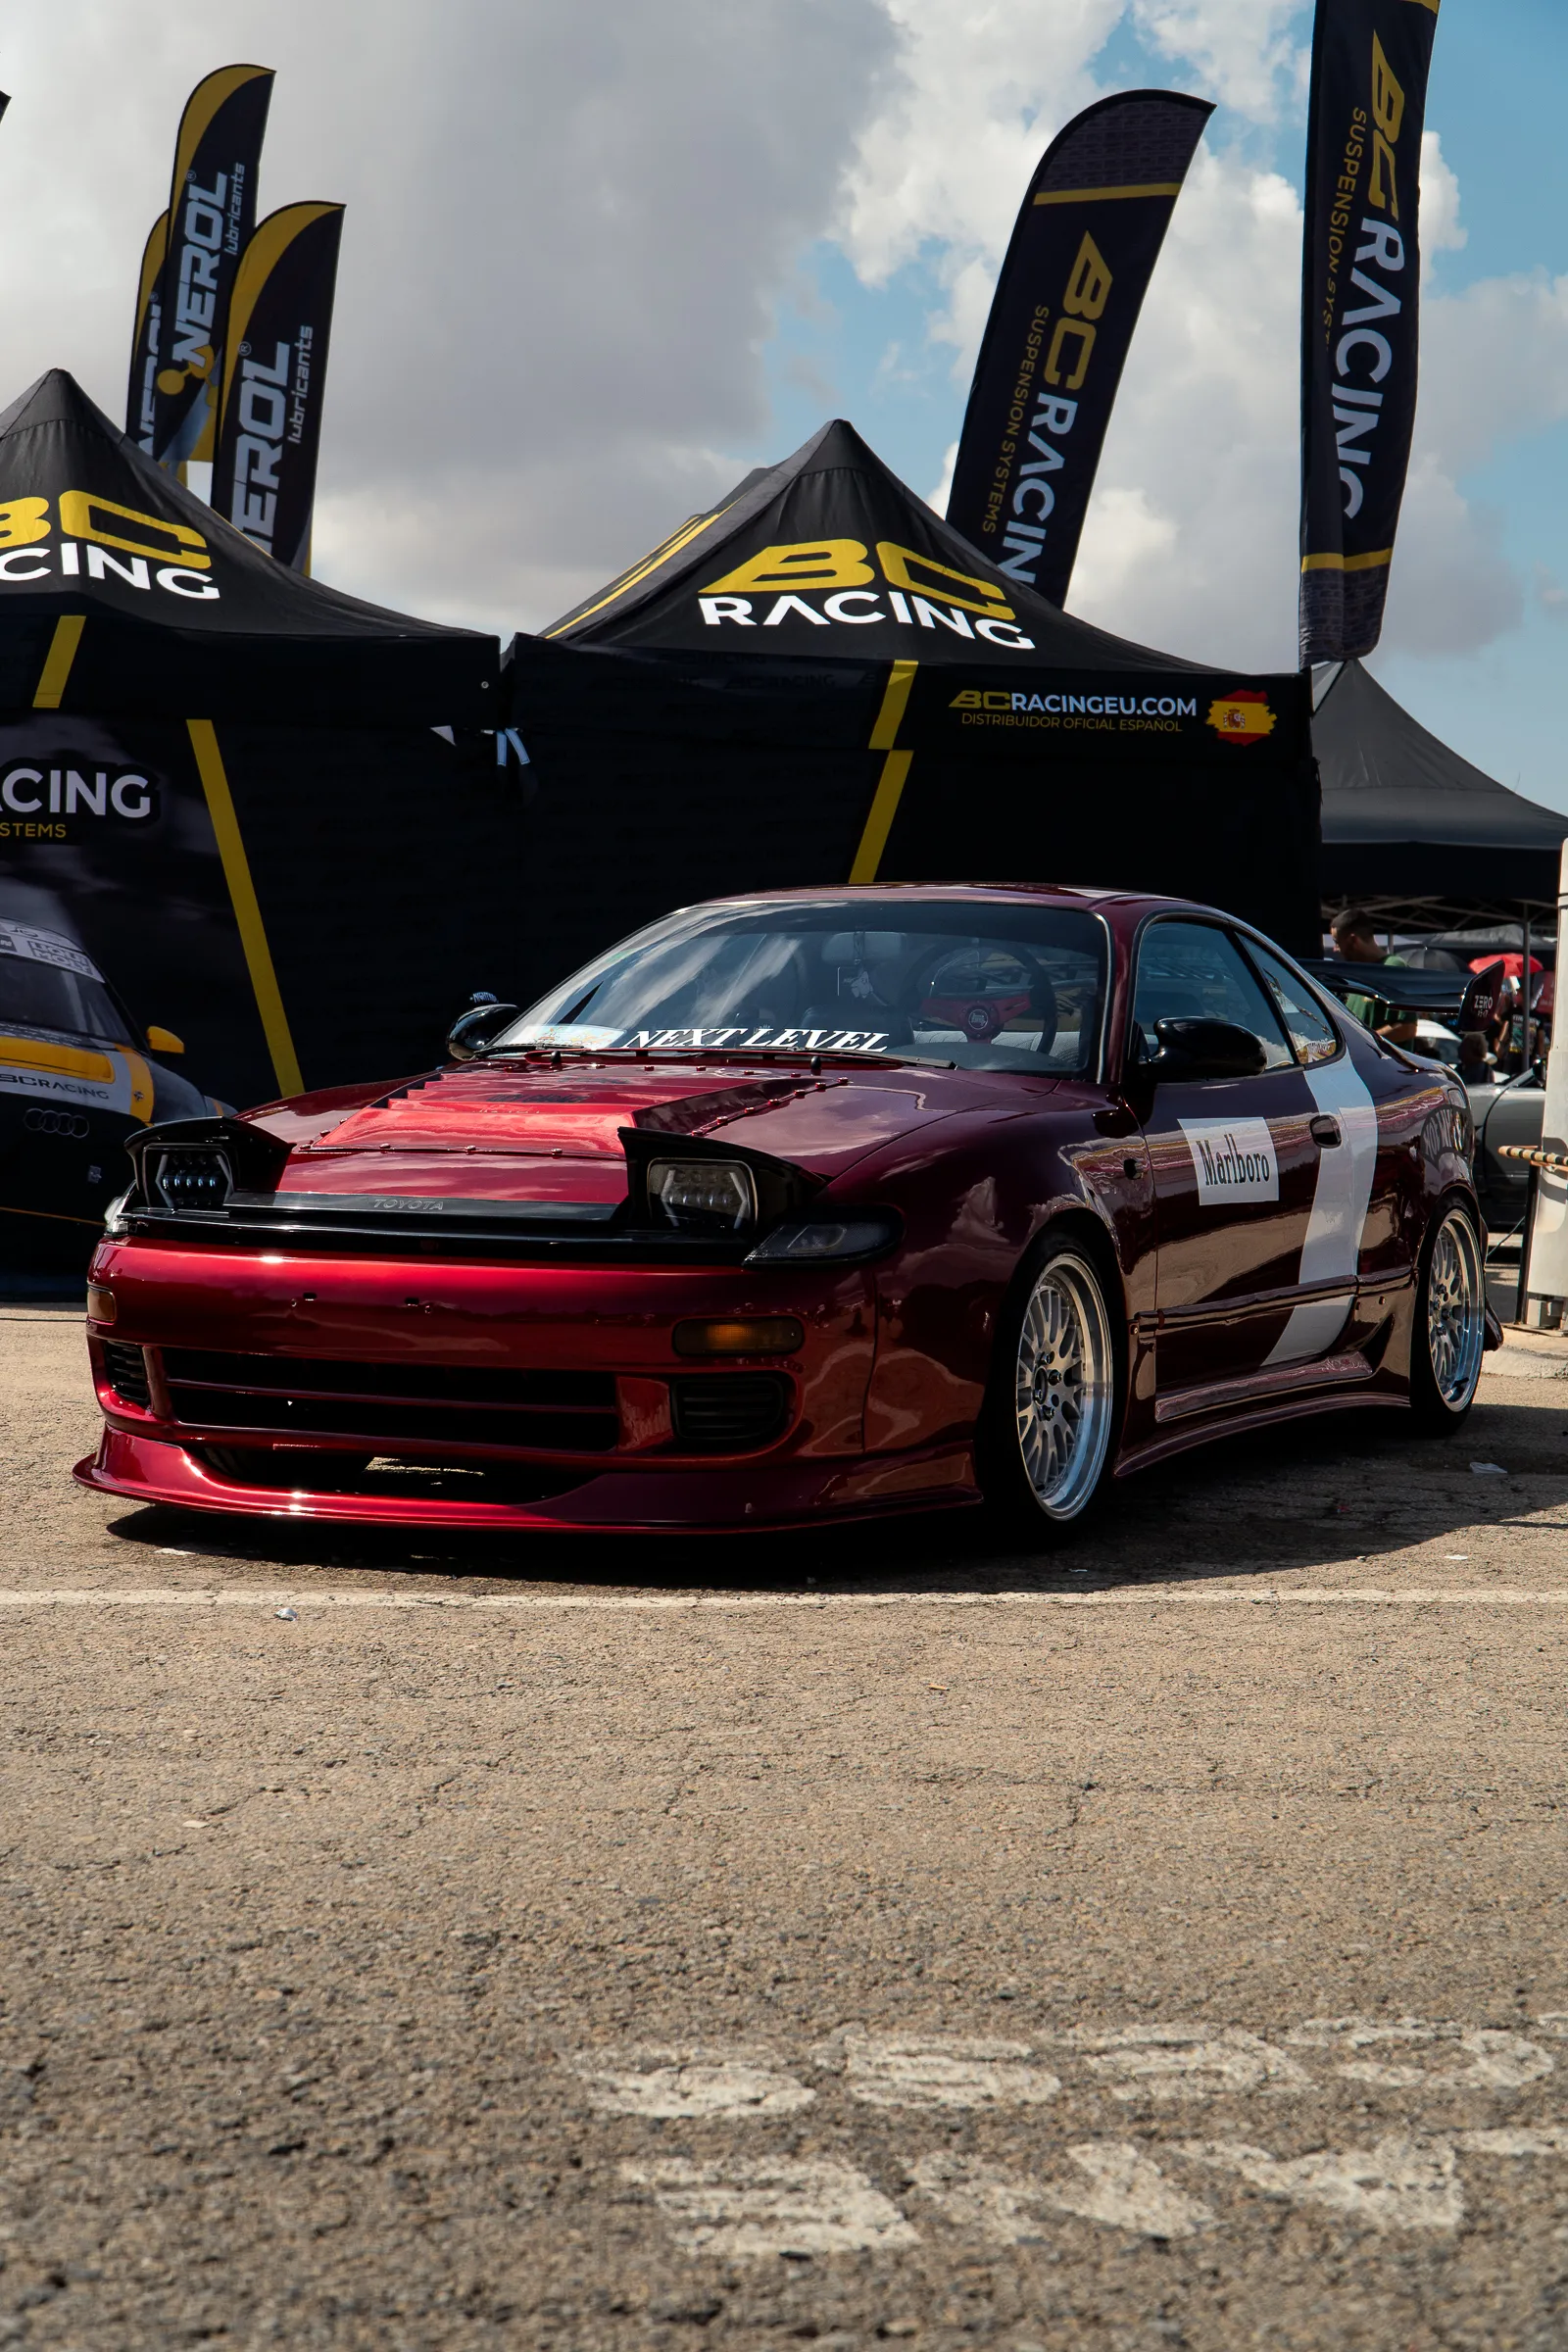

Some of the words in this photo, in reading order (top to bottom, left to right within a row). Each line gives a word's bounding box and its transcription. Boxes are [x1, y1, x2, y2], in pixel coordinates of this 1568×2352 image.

[223, 162, 245, 256] lubricants
[1328, 107, 1367, 273] SUSPENSION
[172, 172, 228, 369] NEROL
[286, 324, 314, 444] lubricants
[1004, 304, 1050, 436] SUSPENSION
[982, 439, 1016, 534] SYSTEMS
[697, 538, 1017, 621] BC
[697, 590, 1037, 650] RACING
[961, 712, 1059, 729] DISTRIBUIDOR
[1063, 717, 1116, 731] OFICIAL
[1119, 717, 1184, 733] ESPAÑOL
[0, 767, 151, 819] CING
[1474, 995, 1494, 1009] ZERO
[622, 1028, 749, 1049] NEXT
[739, 1028, 890, 1053] LEVEL
[1196, 1133, 1271, 1186] Marlboro
[373, 1199, 444, 1210] TOYOTA
